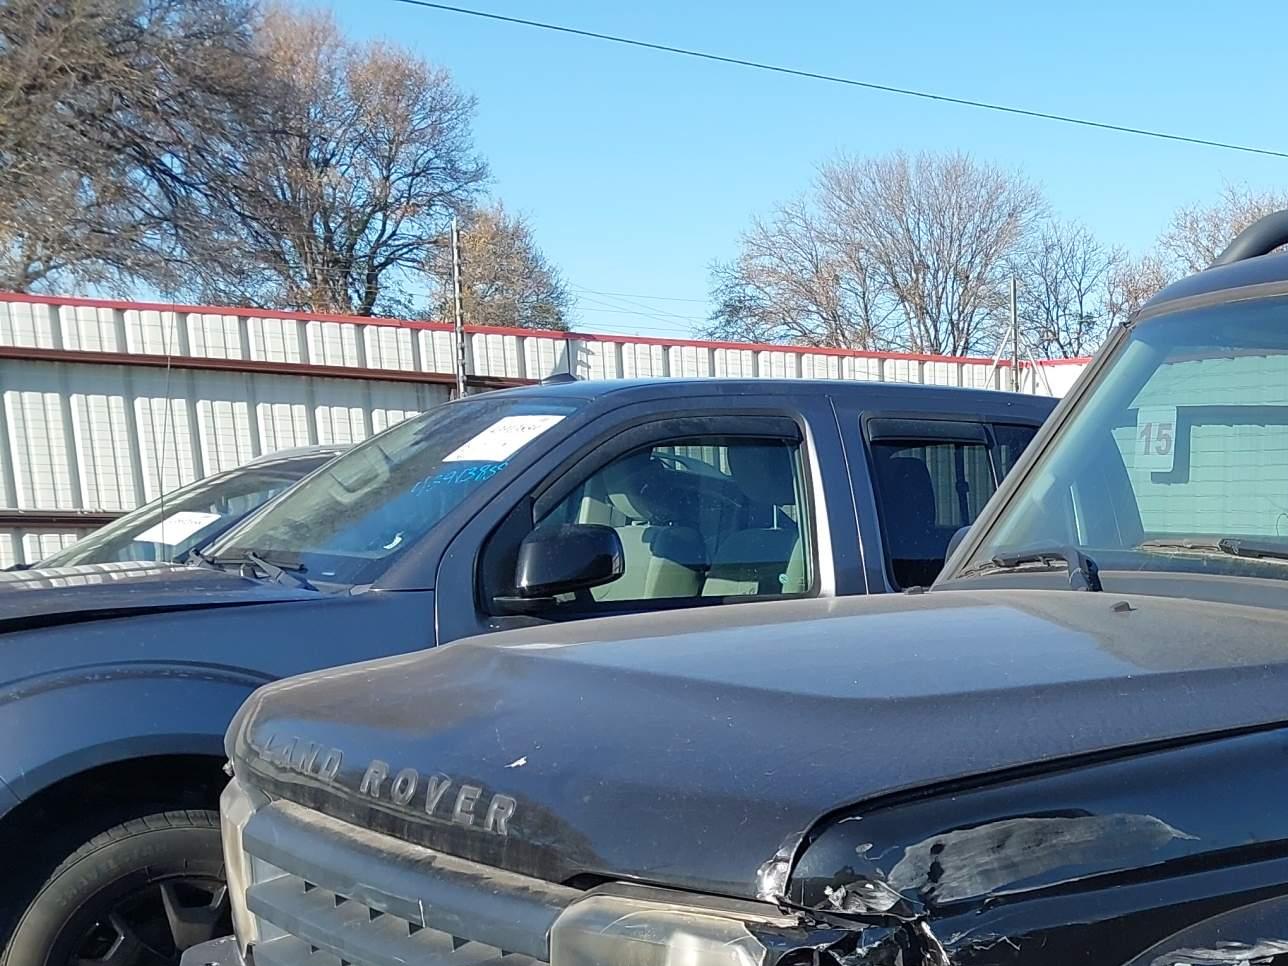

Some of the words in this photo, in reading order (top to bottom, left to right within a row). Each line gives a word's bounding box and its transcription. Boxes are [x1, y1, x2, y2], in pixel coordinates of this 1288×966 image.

[1140, 422, 1173, 456] 15
[262, 734, 345, 783] LAND
[359, 759, 518, 836] ROVER
